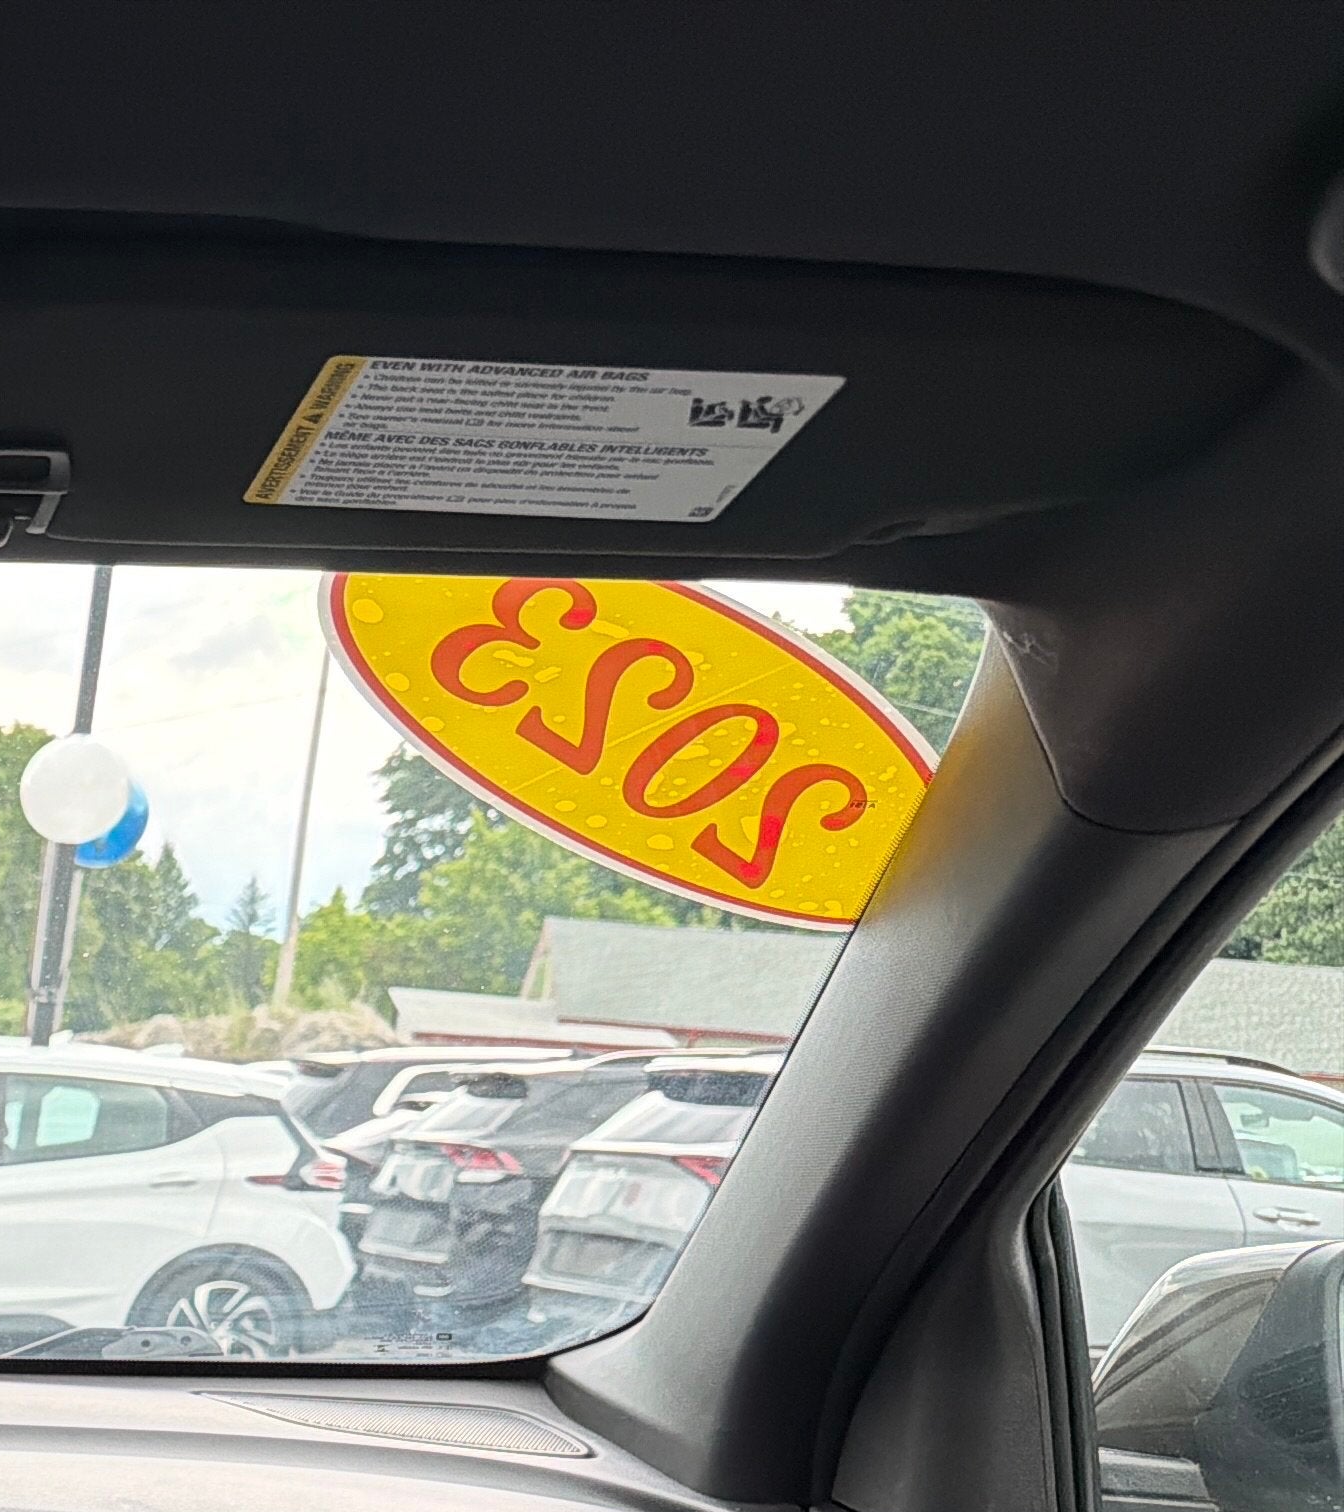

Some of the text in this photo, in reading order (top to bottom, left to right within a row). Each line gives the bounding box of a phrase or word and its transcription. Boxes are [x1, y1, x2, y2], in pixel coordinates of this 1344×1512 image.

[369, 360, 651, 382] EVEN WITH ADVANCED AIR BAGS
[324, 429, 372, 442] MÊME
[373, 433, 415, 445] AVEC
[418, 435, 450, 446] DES
[451, 437, 495, 449] SACS
[497, 440, 596, 453] GONFLABLES
[600, 443, 709, 457] INTELLIGENTS
